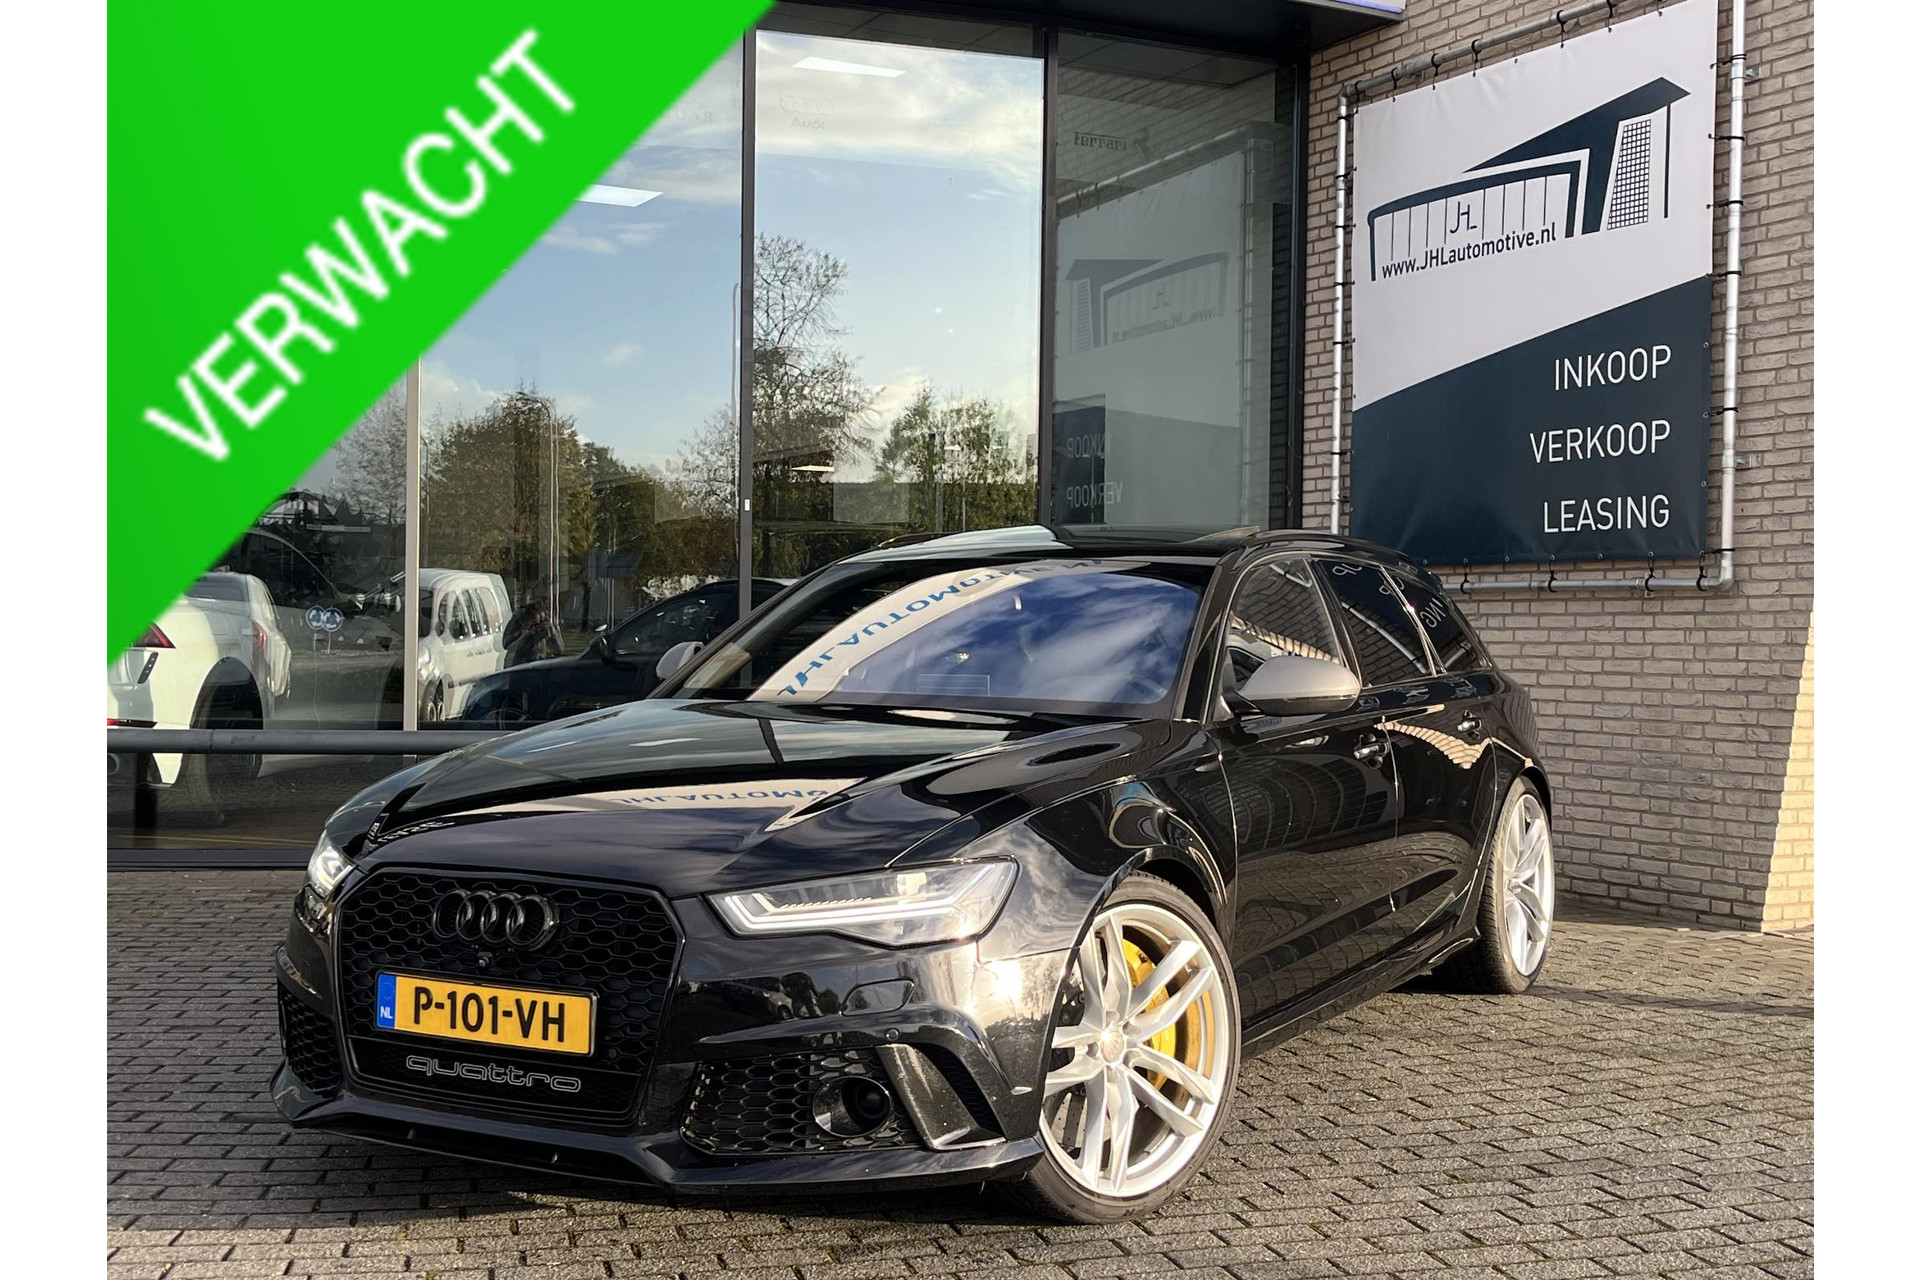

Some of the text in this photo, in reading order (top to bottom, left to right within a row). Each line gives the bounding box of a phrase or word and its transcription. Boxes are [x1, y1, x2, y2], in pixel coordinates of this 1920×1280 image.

[1073, 131, 1128, 151] Ferrari
[1381, 221, 1557, 279] www.JHLautomotive.nl
[1554, 344, 1672, 391] INKOOP
[1529, 419, 1671, 464] VERKOOP
[1543, 493, 1671, 533] LEASING
[379, 1005, 394, 1019] NL
[413, 986, 566, 1043] P-101-VH
[406, 1054, 581, 1093] quattro
